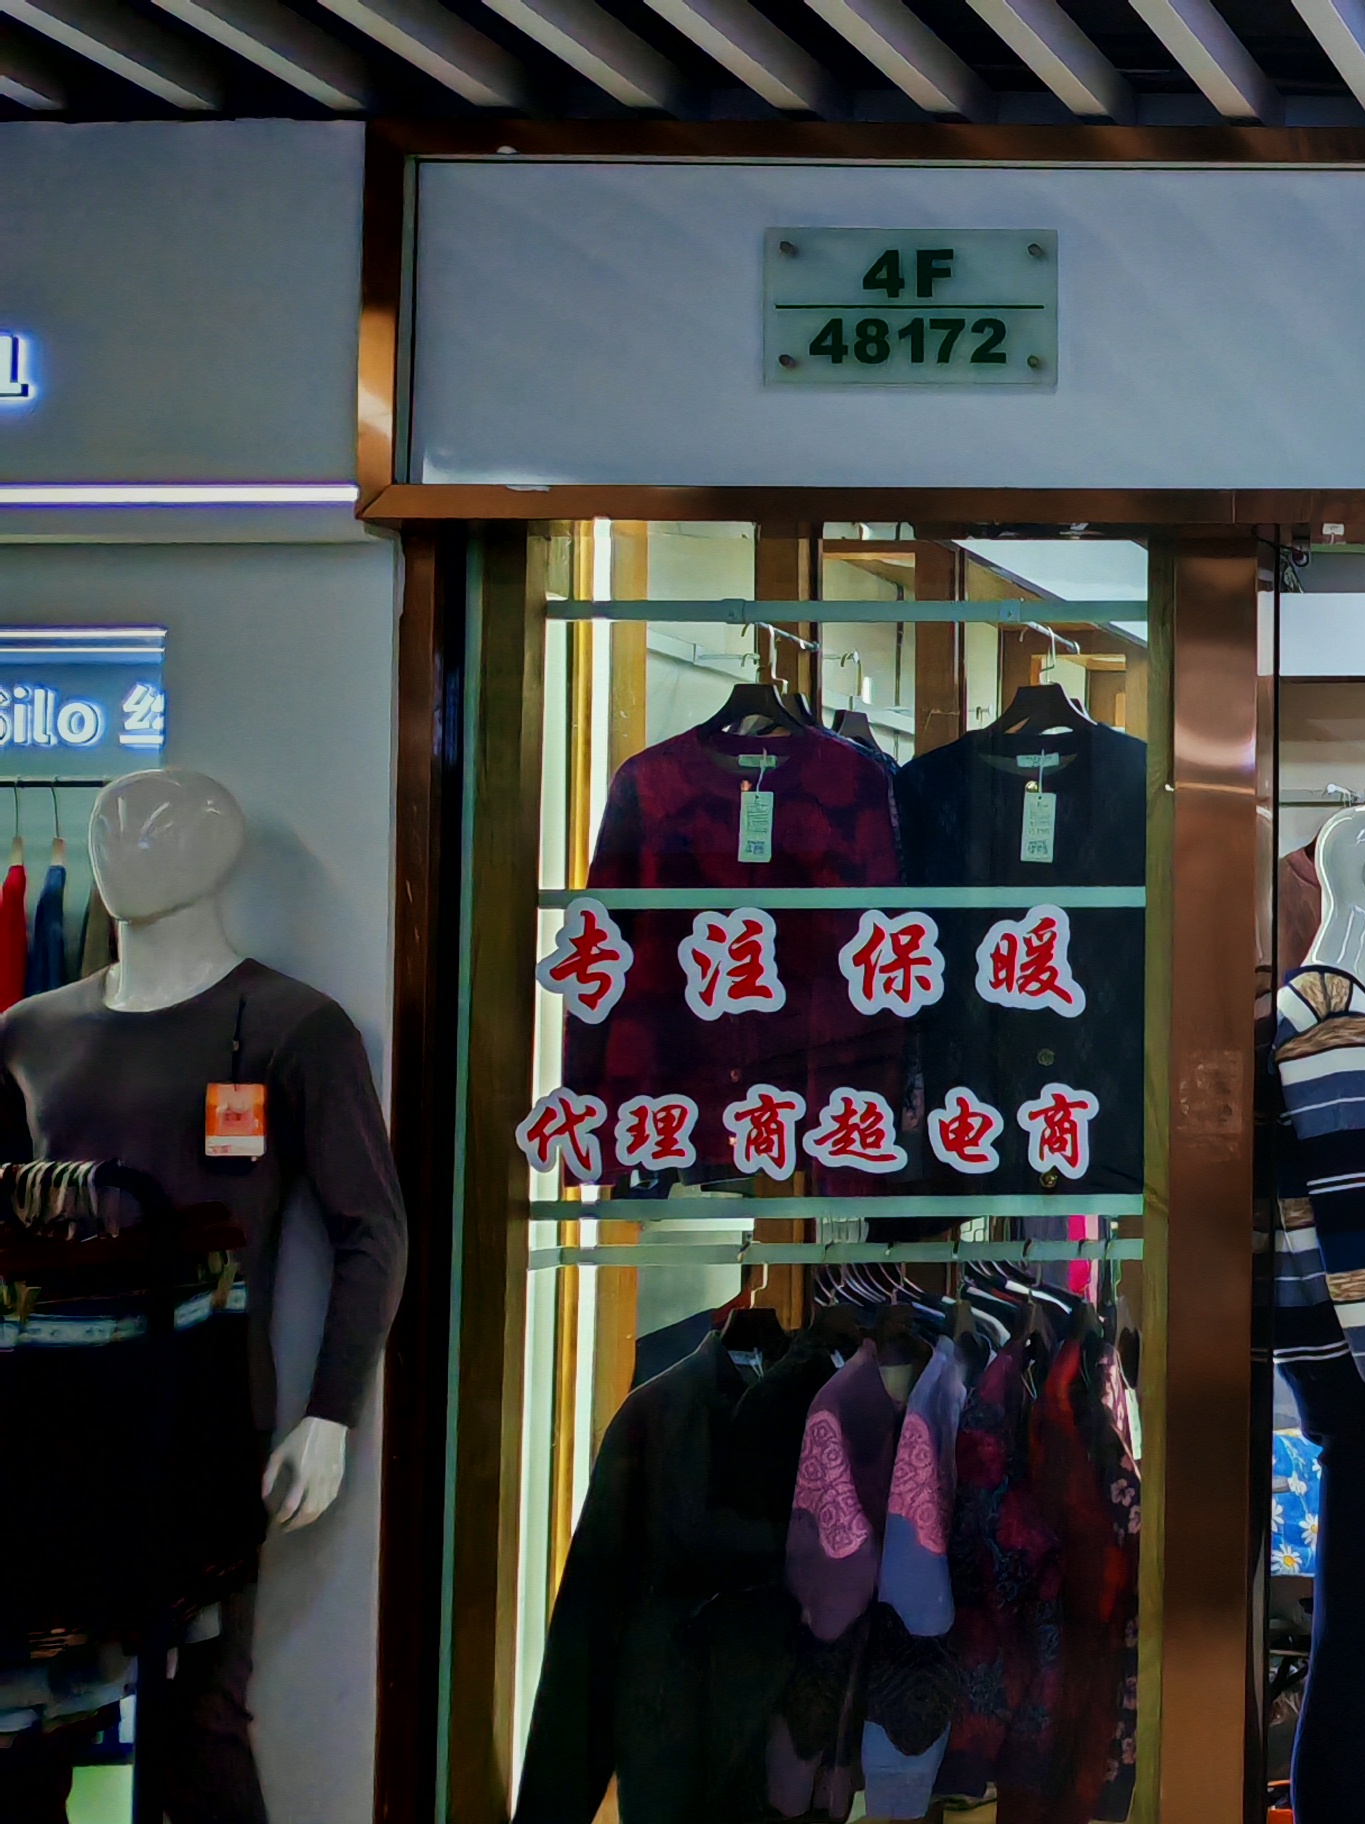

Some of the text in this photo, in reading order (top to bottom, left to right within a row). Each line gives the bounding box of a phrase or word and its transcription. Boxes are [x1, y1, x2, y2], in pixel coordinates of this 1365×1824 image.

[862, 248, 954, 298] 4F
[809, 317, 1007, 364] 48172
[0, 683, 100, 744] ilo
[549, 909, 1075, 1011] 专注保暖
[526, 1092, 1091, 1171] 代理商超电商
